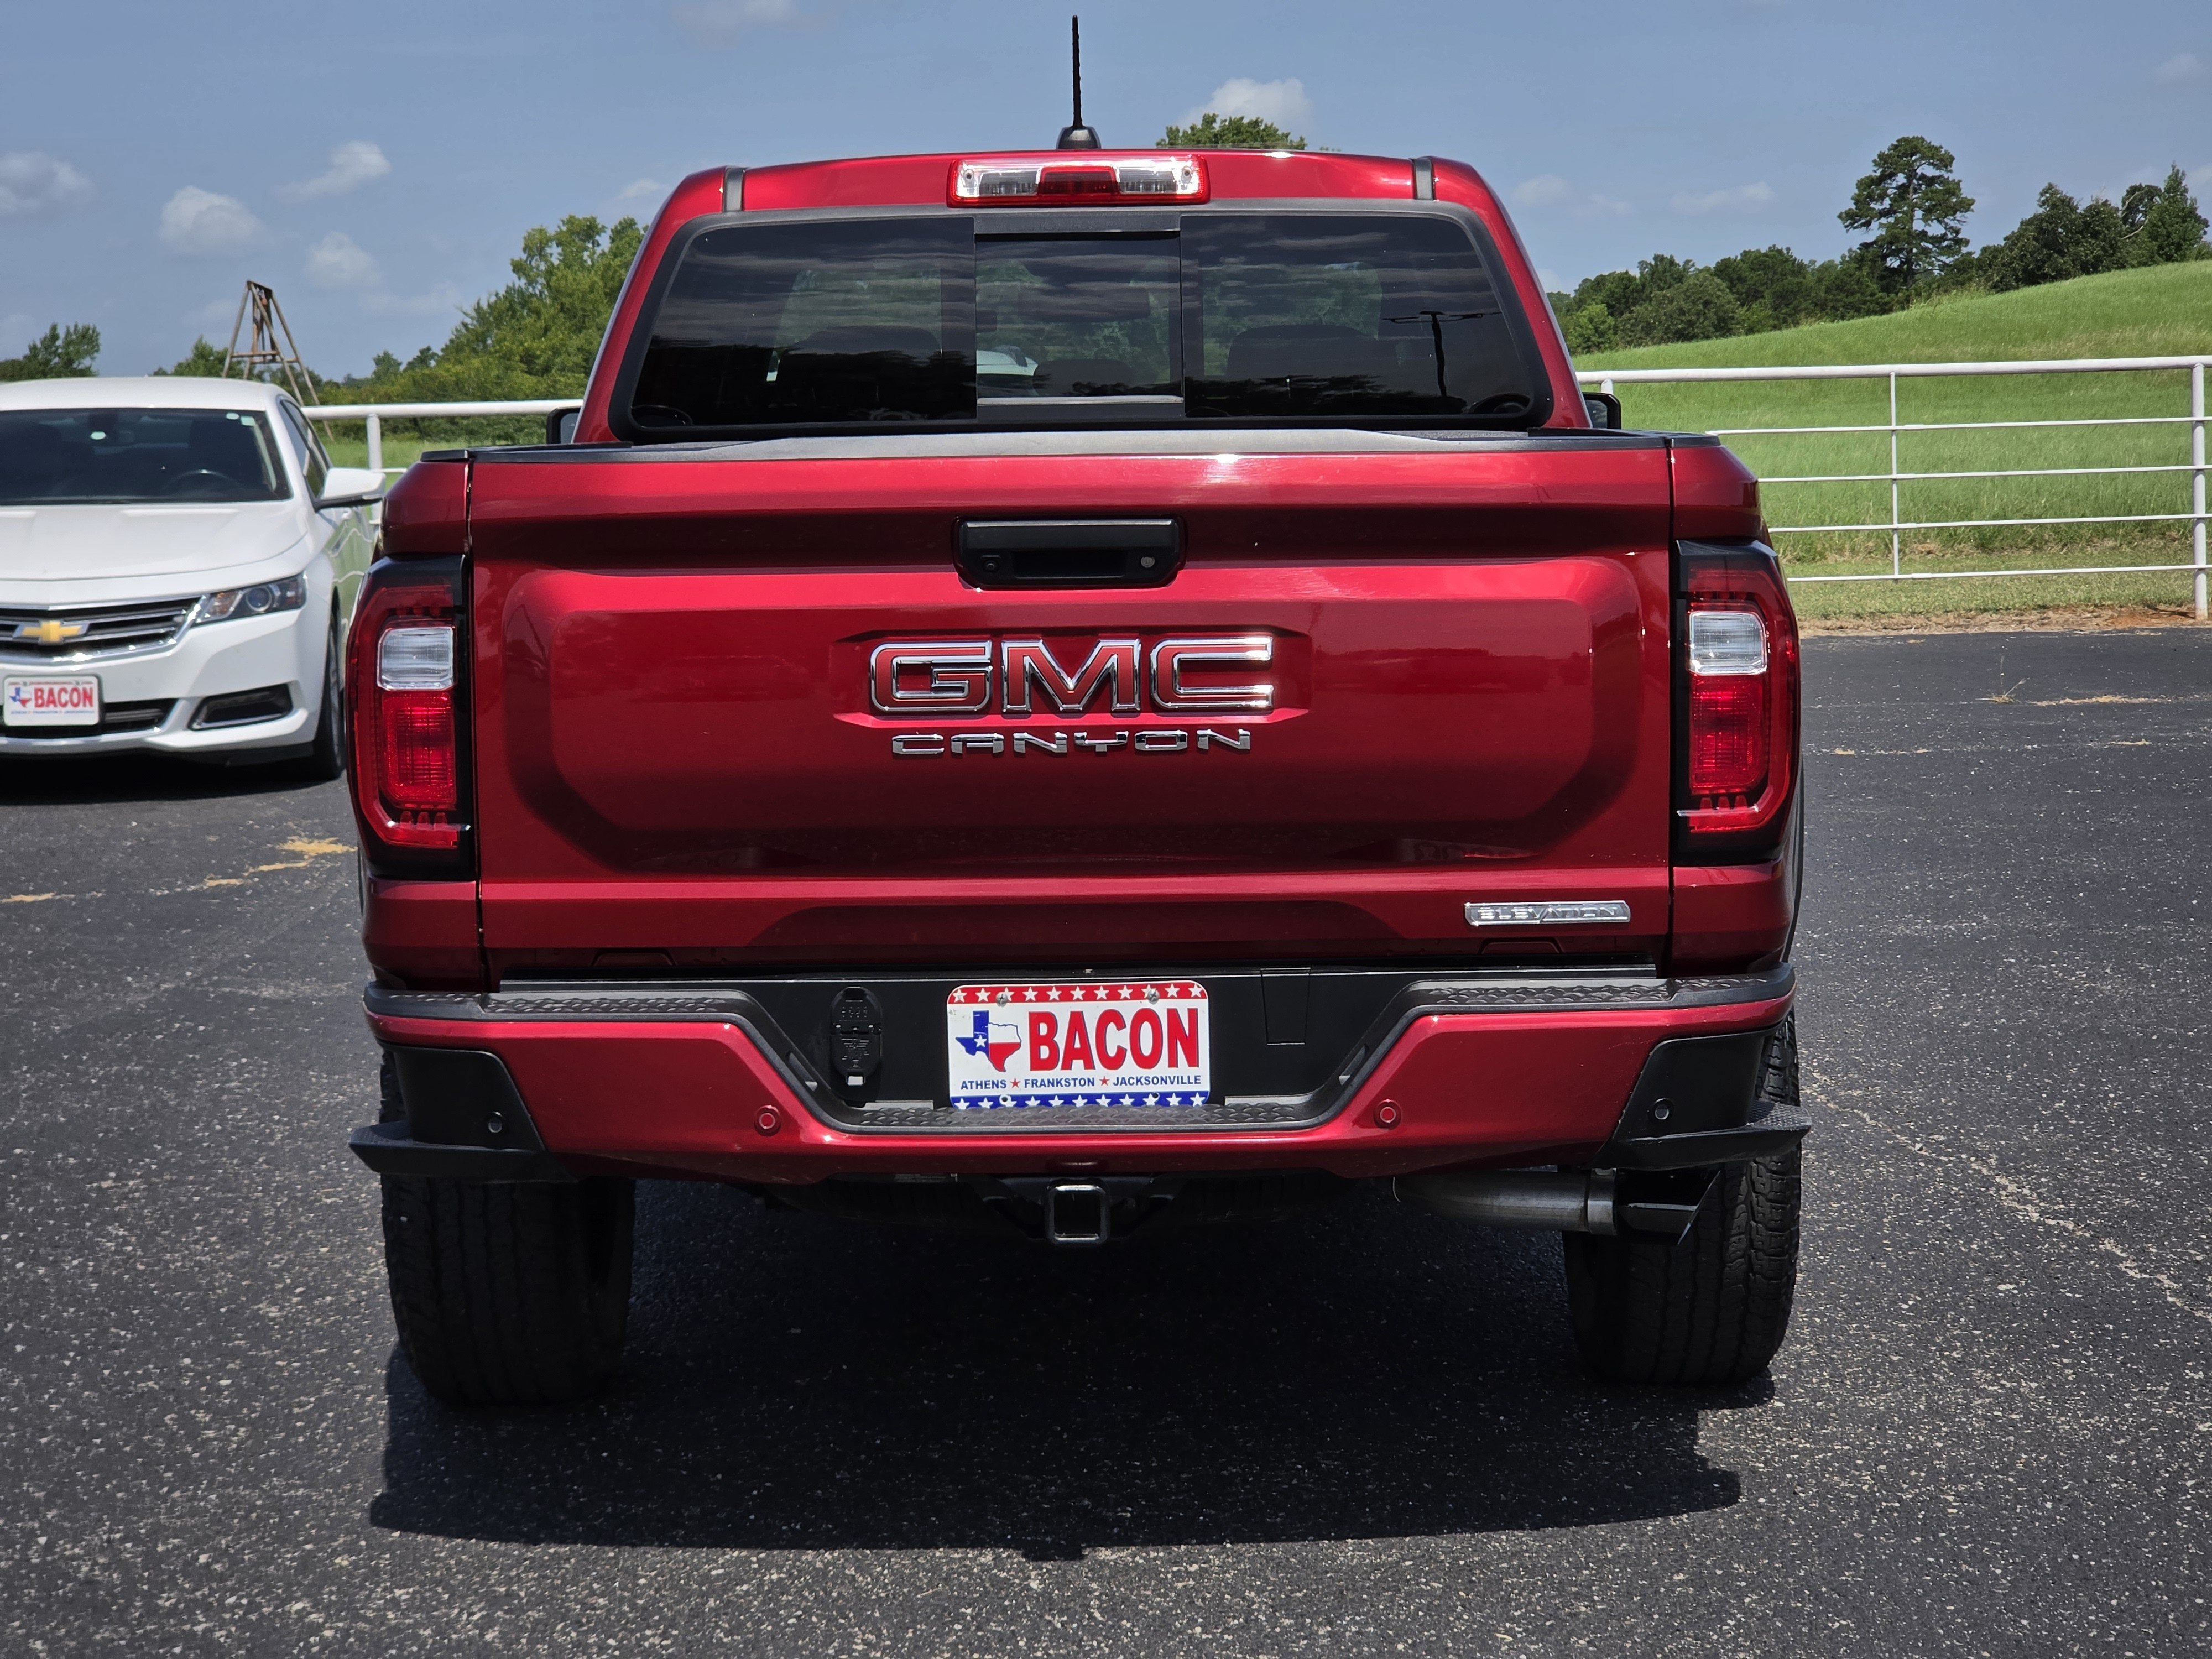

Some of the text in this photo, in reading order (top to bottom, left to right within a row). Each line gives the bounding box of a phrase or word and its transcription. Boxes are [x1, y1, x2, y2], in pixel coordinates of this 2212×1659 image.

[870, 637, 1274, 712] GMC
[34, 687, 93, 708] BACON
[892, 729, 1250, 753] CANYON
[1028, 1008, 1199, 1071] BACON
[961, 1074, 1201, 1090] ATHENS FRANKSTON JACKSONVILLE
